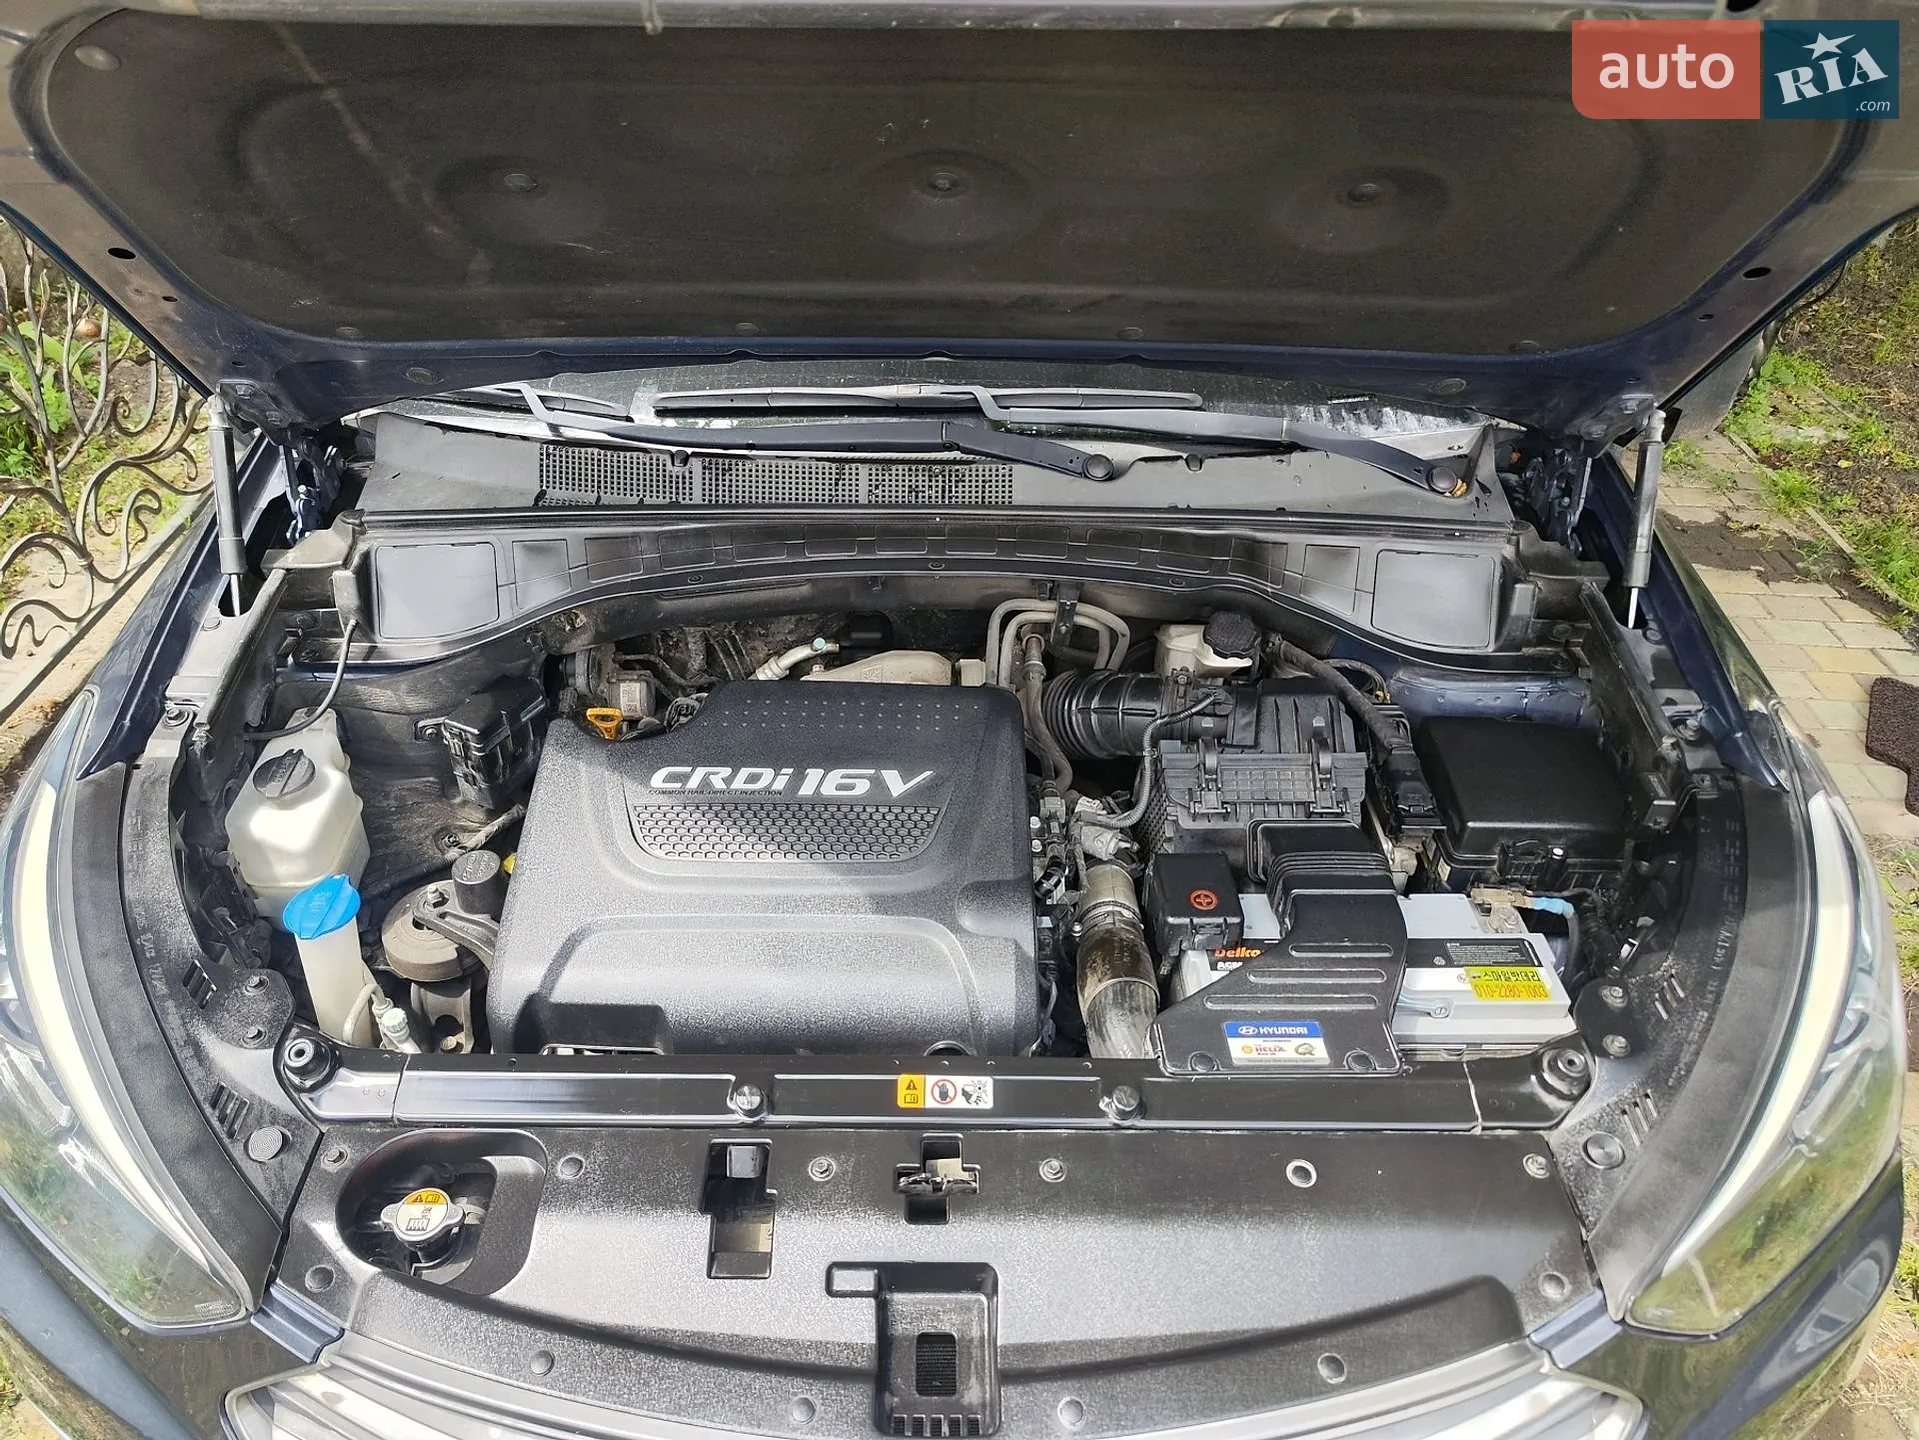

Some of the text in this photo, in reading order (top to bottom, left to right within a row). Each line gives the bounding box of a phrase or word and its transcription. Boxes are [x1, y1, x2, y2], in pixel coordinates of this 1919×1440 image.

[650, 766, 935, 798] CRDi 16V
[1259, 1026, 1308, 1035] HYUNDAI
